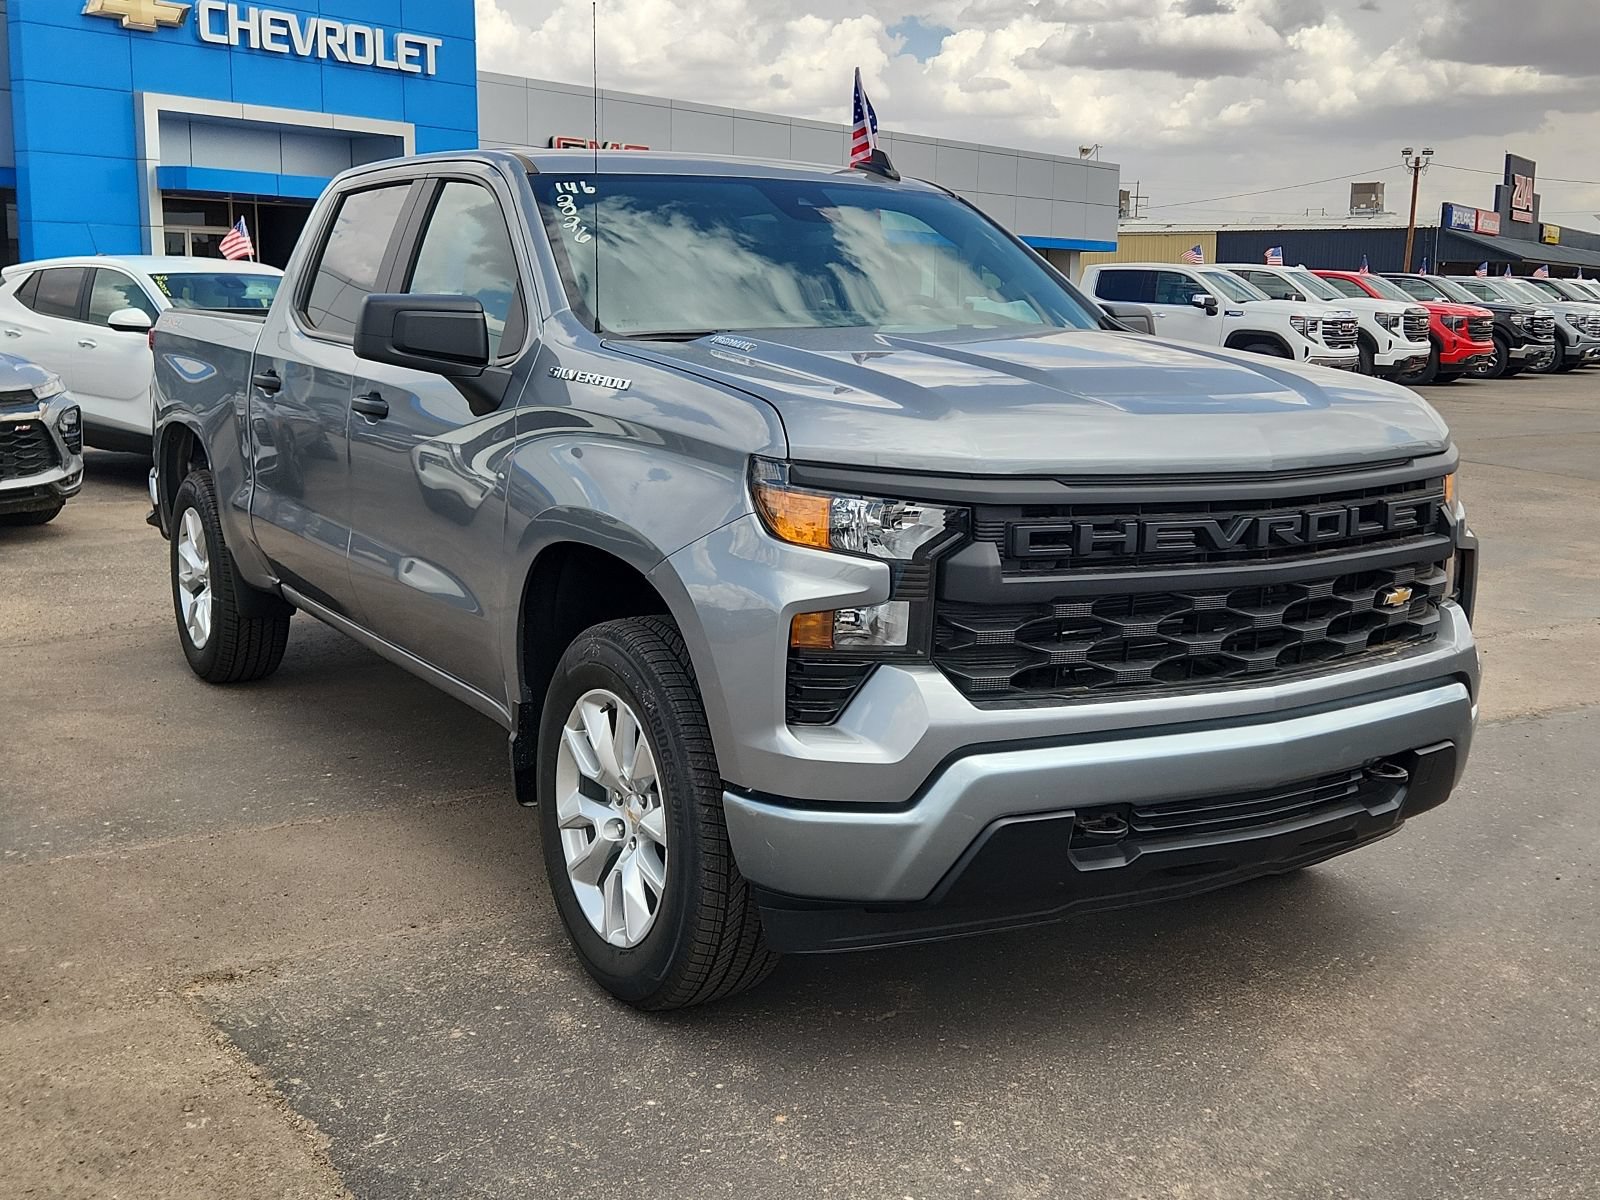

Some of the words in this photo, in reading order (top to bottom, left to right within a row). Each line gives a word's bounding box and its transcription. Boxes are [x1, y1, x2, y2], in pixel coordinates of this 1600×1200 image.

[196, 0, 443, 75] CHEVROLET
[555, 181, 596, 194] 146
[549, 366, 632, 391] SILVERADO
[1005, 496, 1445, 558] CHEVROLET
